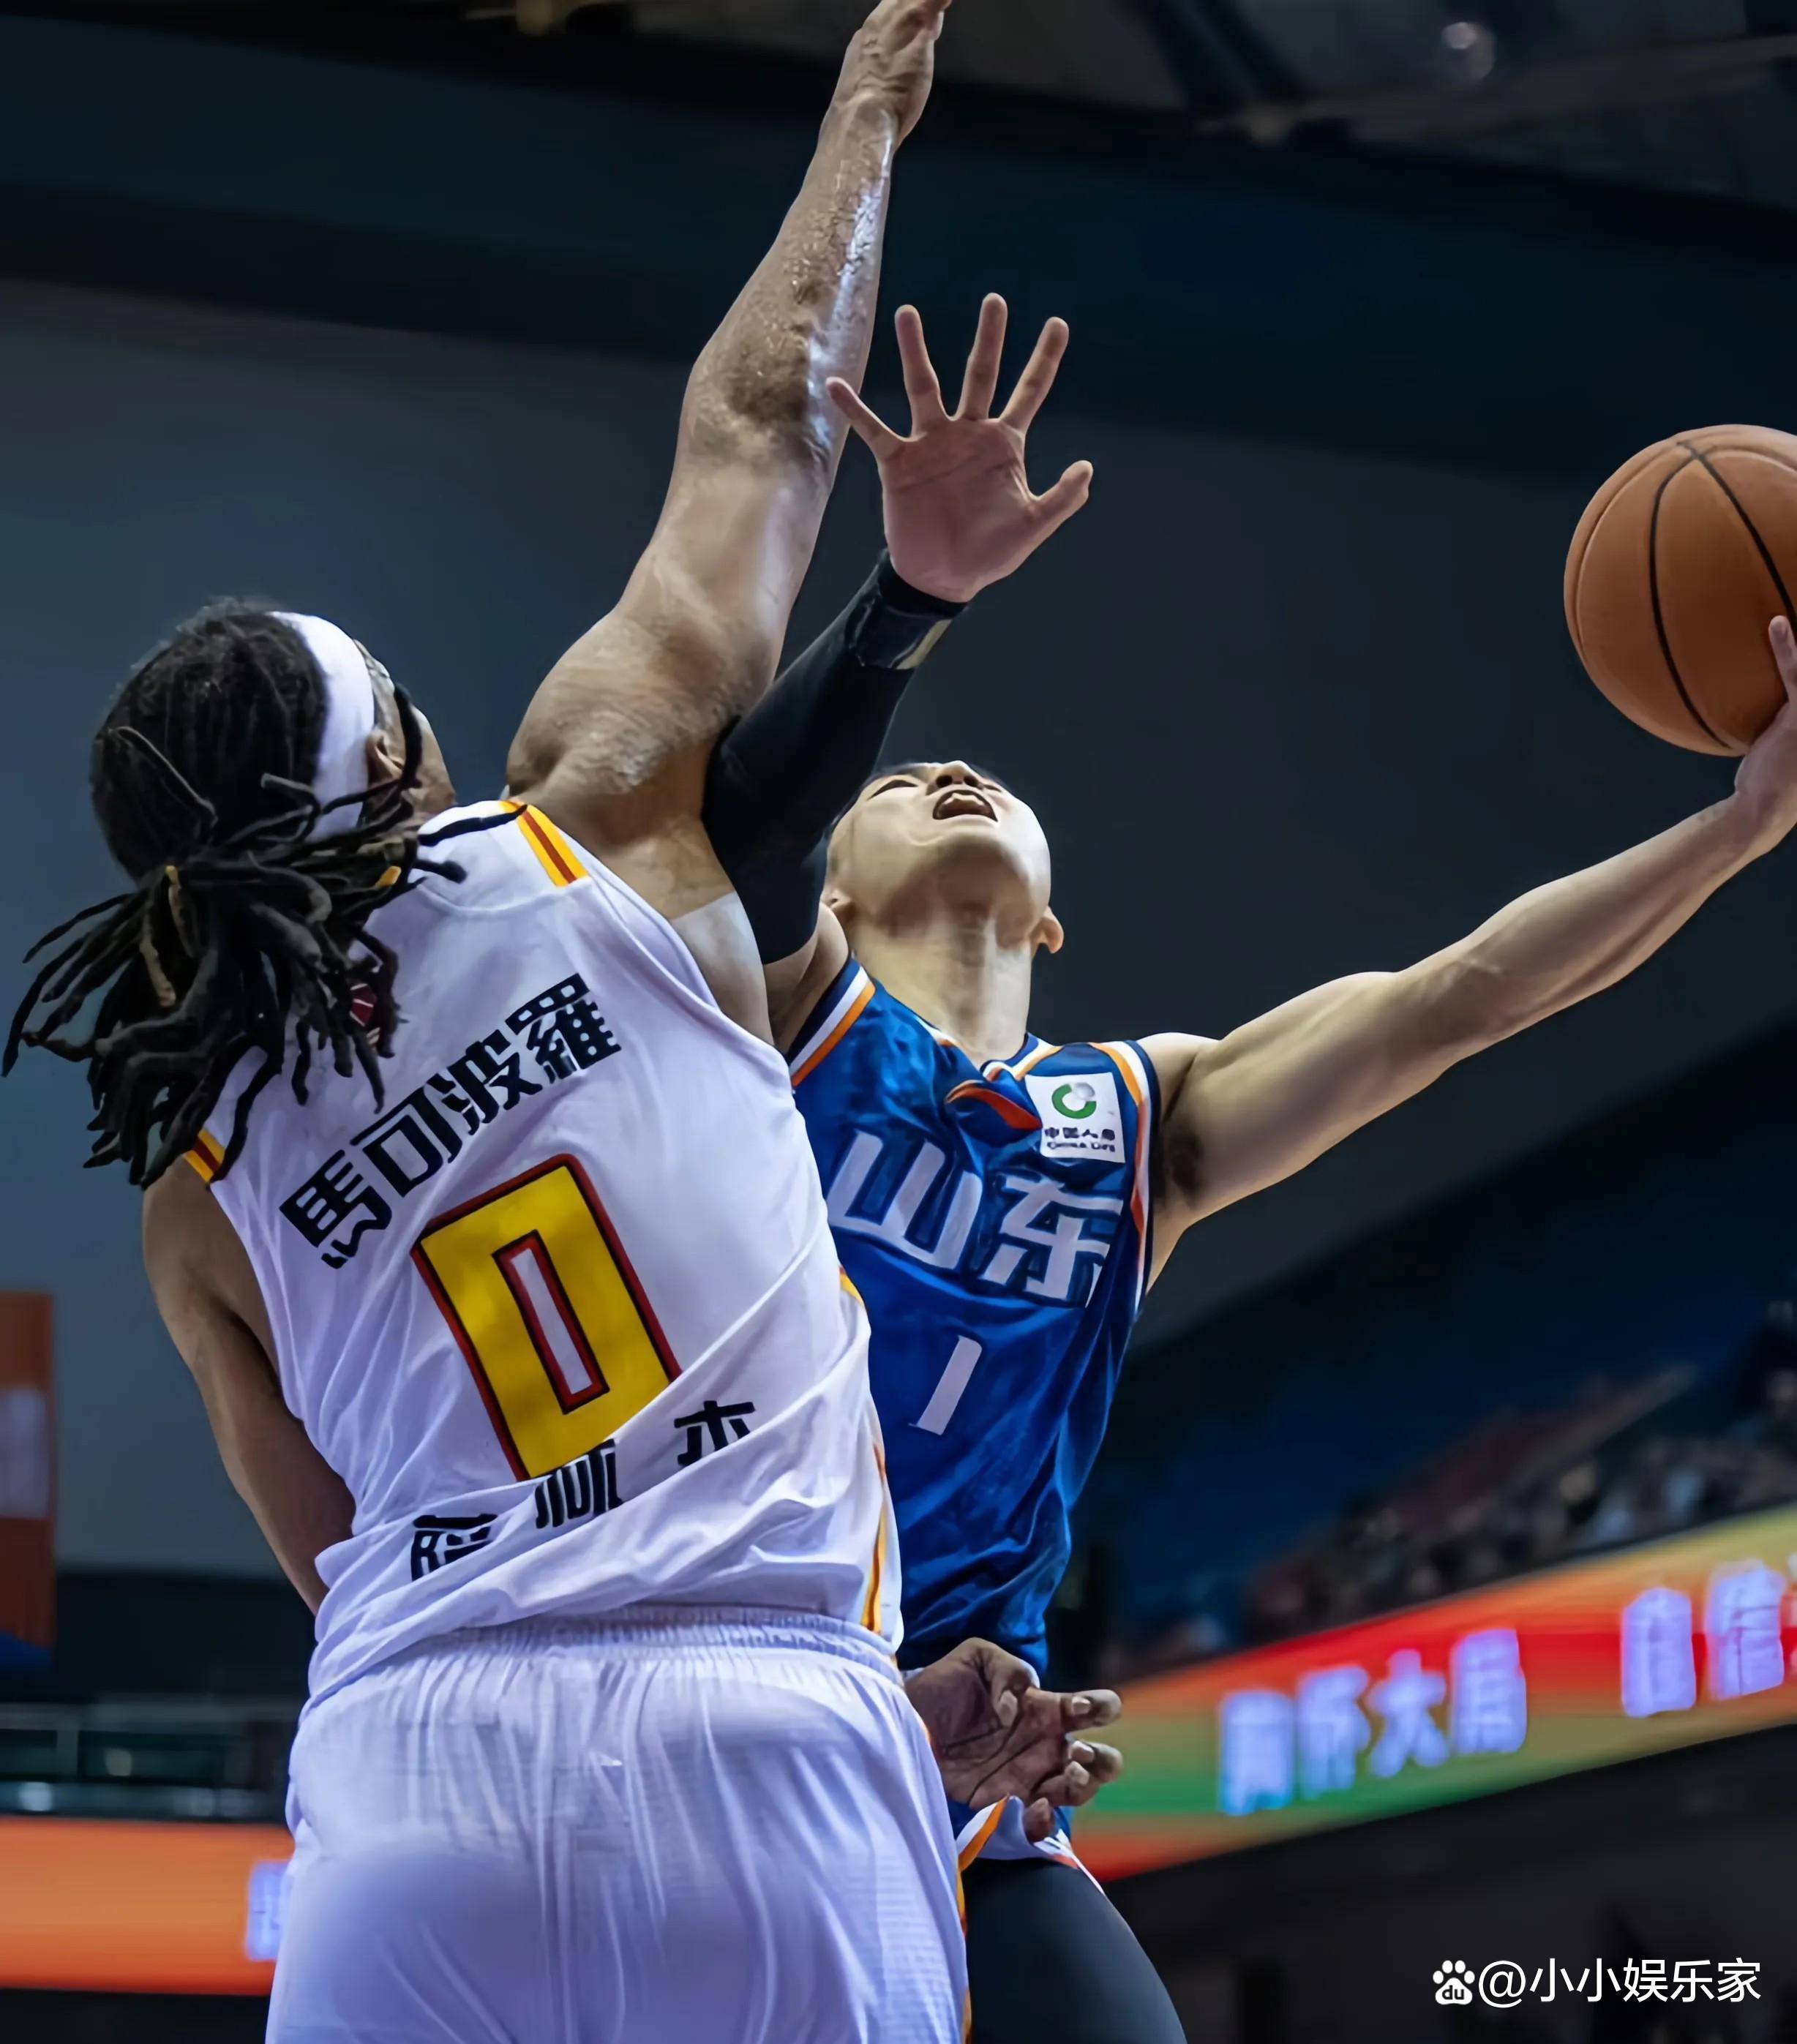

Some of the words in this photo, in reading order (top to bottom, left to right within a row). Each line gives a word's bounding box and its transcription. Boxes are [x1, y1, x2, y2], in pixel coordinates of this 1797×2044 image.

[280, 974, 620, 1269] 馬可波羅
[826, 1130, 1124, 1307] 山东
[410, 1153, 682, 1481] 0
[916, 1336, 982, 1435] 1
